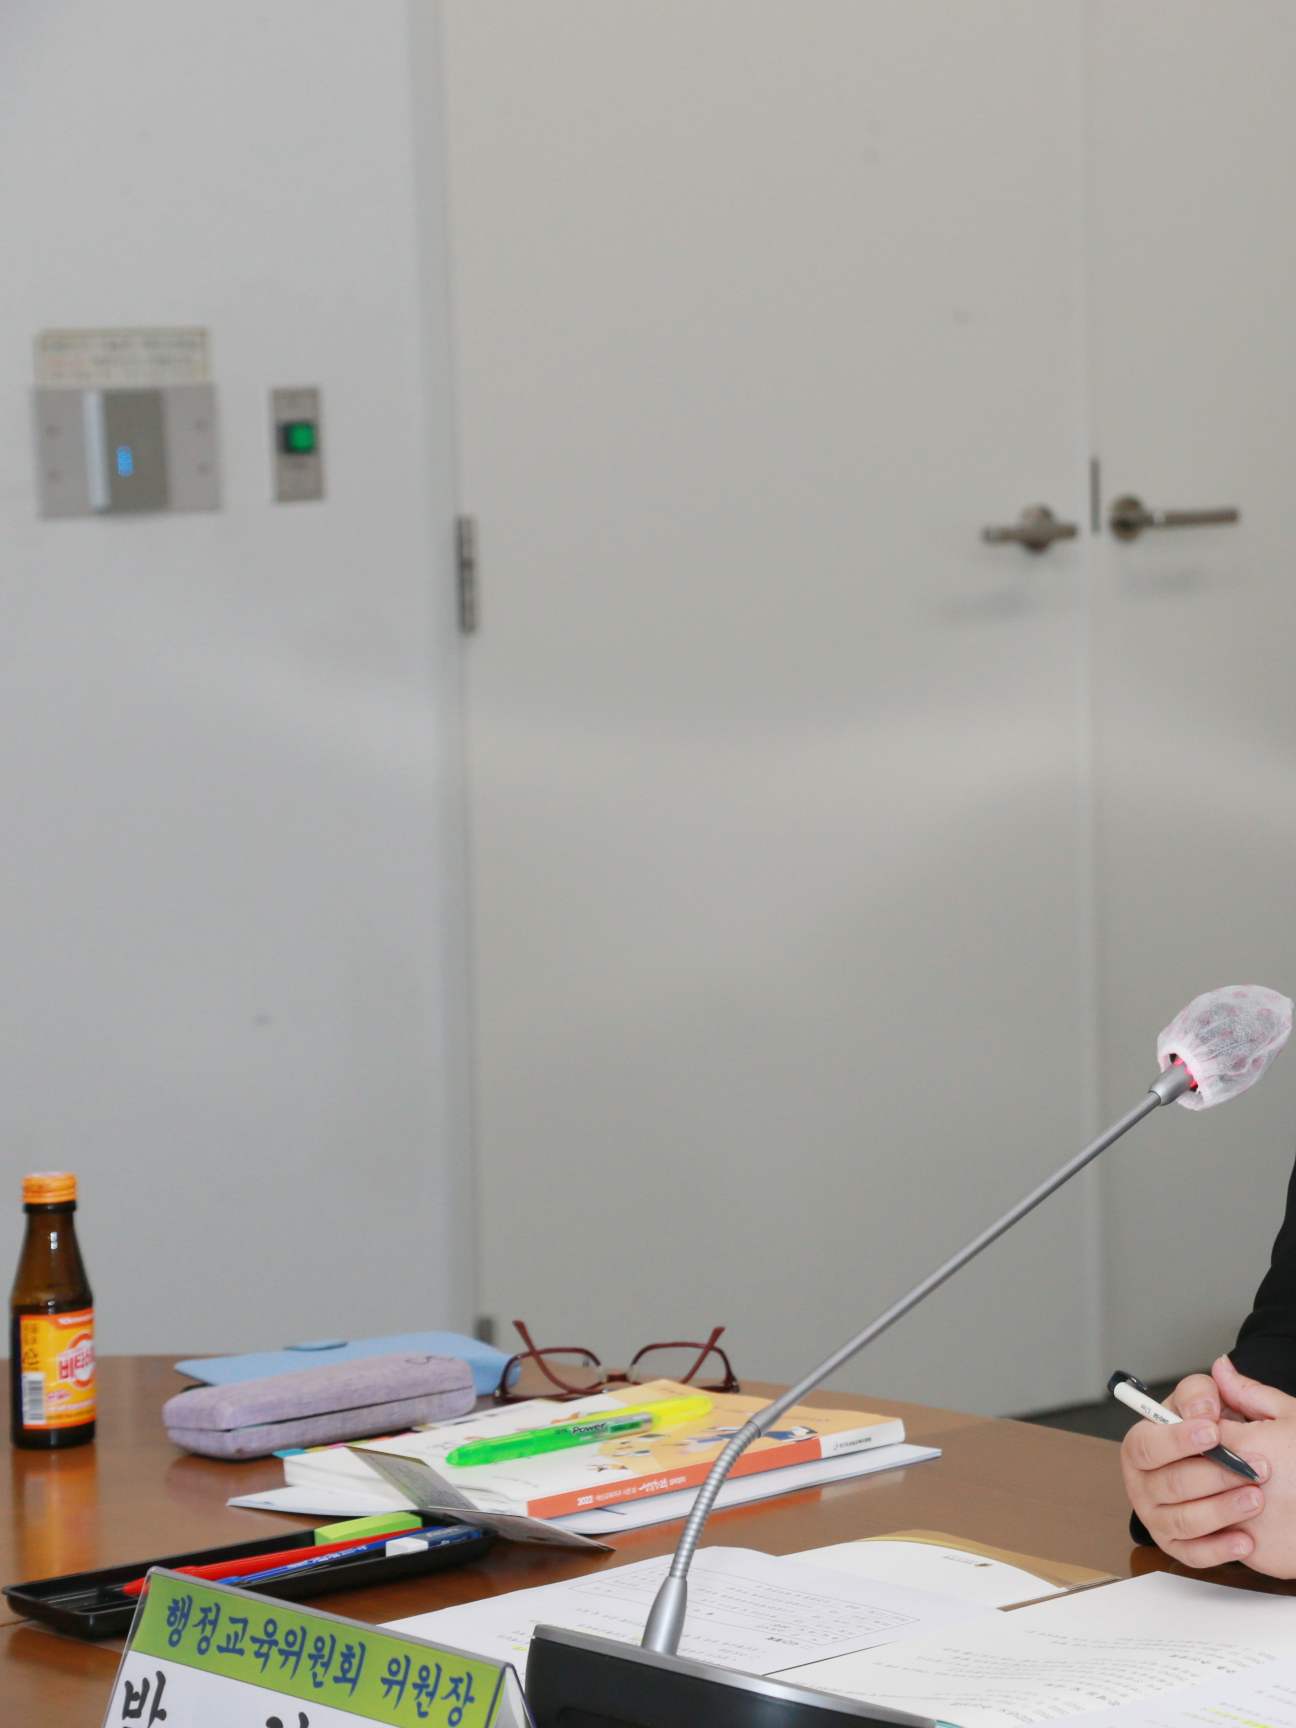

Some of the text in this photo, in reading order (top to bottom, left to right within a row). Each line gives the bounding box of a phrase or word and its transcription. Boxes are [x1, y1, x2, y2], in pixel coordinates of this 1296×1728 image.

[571, 1422, 607, 1436] Power
[576, 1495, 594, 1506] 2022
[166, 1594, 475, 1728] 행정교육위원회 위원장
